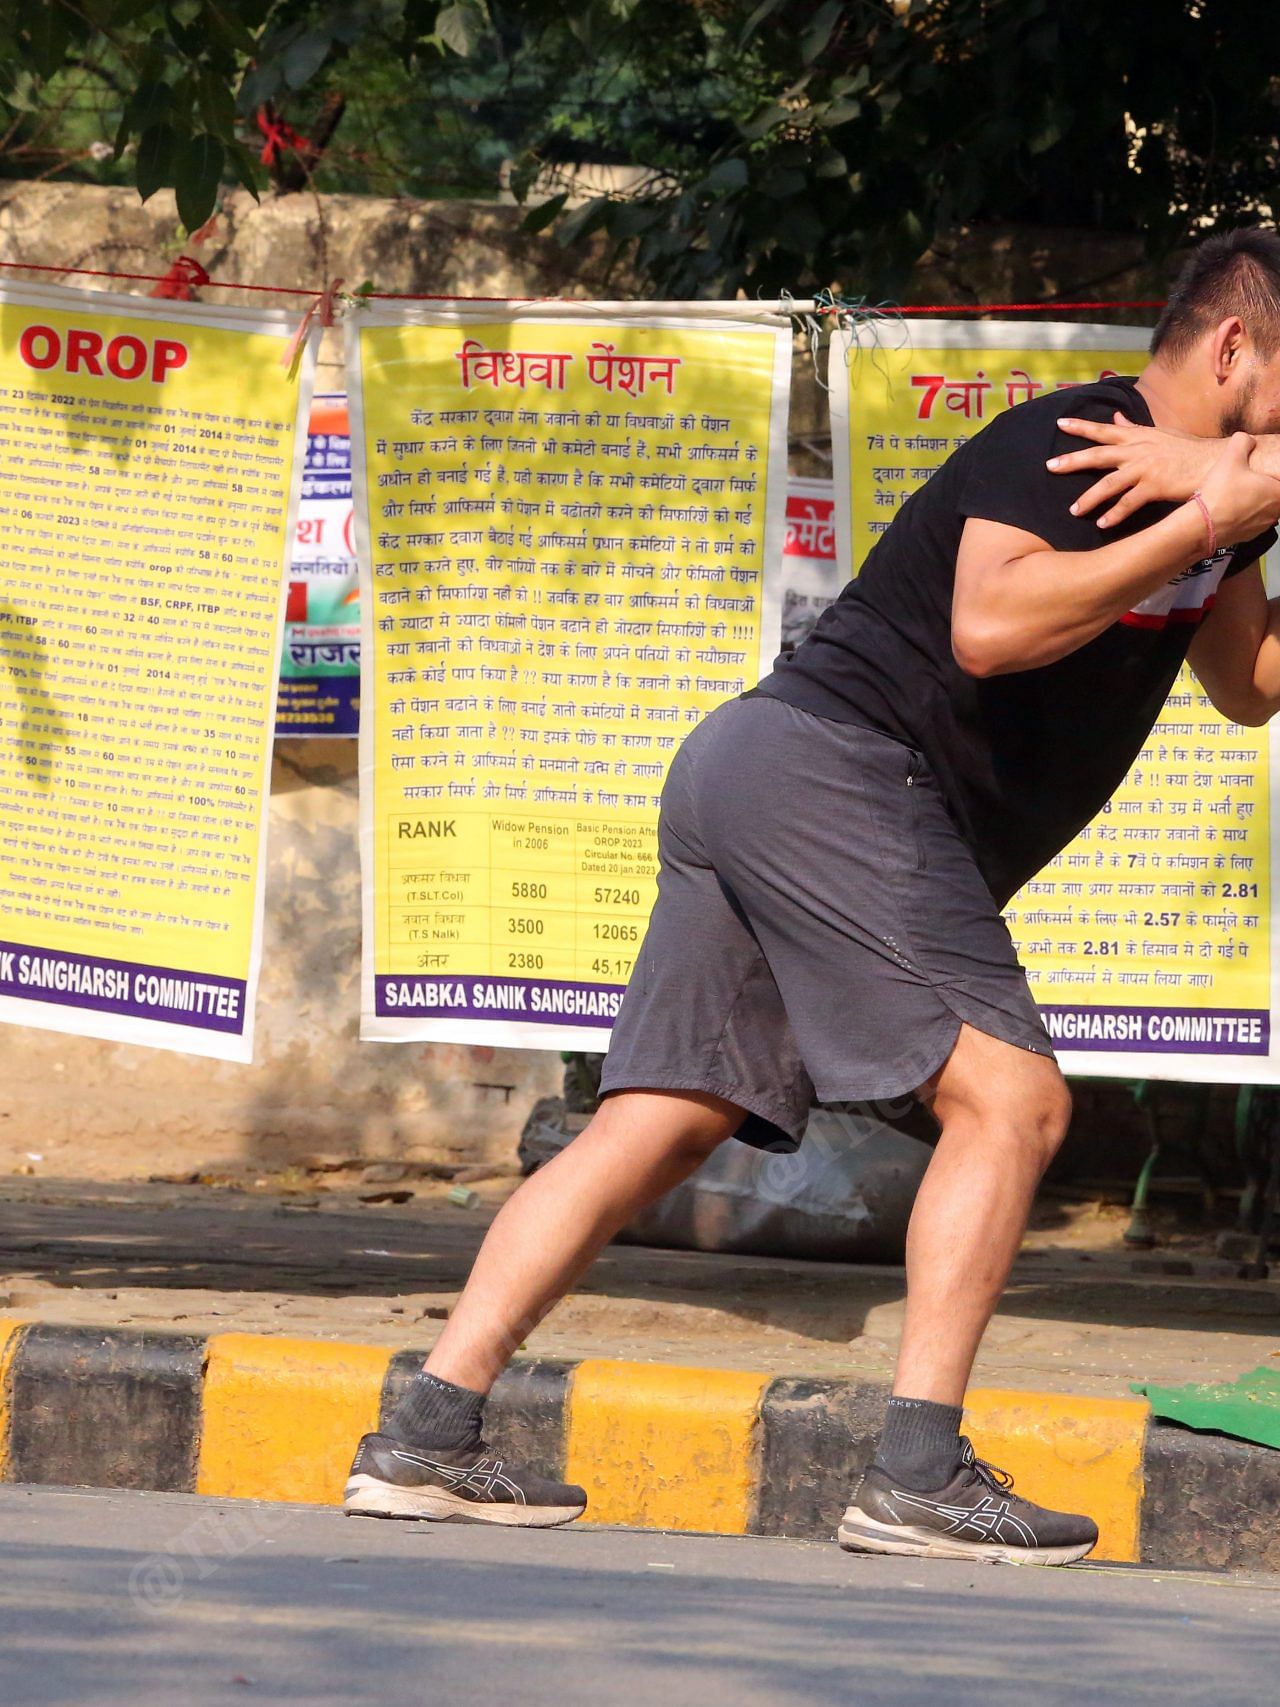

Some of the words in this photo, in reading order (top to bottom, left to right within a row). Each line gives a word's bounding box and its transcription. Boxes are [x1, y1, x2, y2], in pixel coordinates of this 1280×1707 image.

[20, 325, 188, 383] OROP
[456, 340, 573, 389] विधवा
[586, 343, 681, 398] पेंशन
[51, 394, 75, 405] 2022
[911, 371, 991, 419] 7वां
[164, 424, 176, 434] 01
[200, 429, 222, 440] 2014
[136, 439, 147, 449] 01
[173, 443, 196, 454] 2014
[905, 435, 948, 450] कमिशन
[89, 465, 100, 475] 58
[21, 510, 32, 520] 06
[57, 515, 80, 526] 2023
[150, 563, 172, 575] orop
[197, 603, 220, 614] ITBP
[1220, 751, 1258, 761] सरकार
[1166, 775, 1188, 786] क्या
[1193, 771, 1212, 787] देश
[1219, 775, 1254, 786] भावना
[189, 796, 214, 807] 100%
[398, 820, 457, 839] RANK
[492, 819, 525, 833] Widow
[528, 822, 569, 835] Pension
[577, 823, 599, 833] Basic
[602, 824, 637, 836] Pension
[639, 826, 656, 837] Afte
[513, 837, 521, 848] in
[525, 838, 548, 849] 2006
[594, 837, 620, 846] OROP
[622, 839, 643, 848] 2023
[584, 849, 618, 860] Circular
[582, 862, 606, 872] Dated
[609, 864, 618, 873] 20
[636, 865, 655, 875] 2023
[512, 882, 547, 899] 5880
[594, 887, 640, 905] 57240
[1222, 883, 1258, 898] 2.81
[508, 918, 544, 935] 3500
[1144, 913, 1180, 926] 2.57
[593, 924, 638, 941] 12065
[1083, 941, 1118, 955] 2.81
[418, 951, 450, 968] अंतर
[508, 953, 543, 969] 2380
[592, 958, 632, 976] 45,17
[18, 954, 129, 1001] SANGHARSH
[134, 974, 240, 1019] COMMITTEE
[385, 982, 467, 1007] SAABKA
[473, 984, 527, 1010] SANIK
[531, 988, 625, 1016] SANGHARS
[1040, 1013, 1142, 1040] NGHARSH
[1148, 1015, 1261, 1043] COMMITTEE
